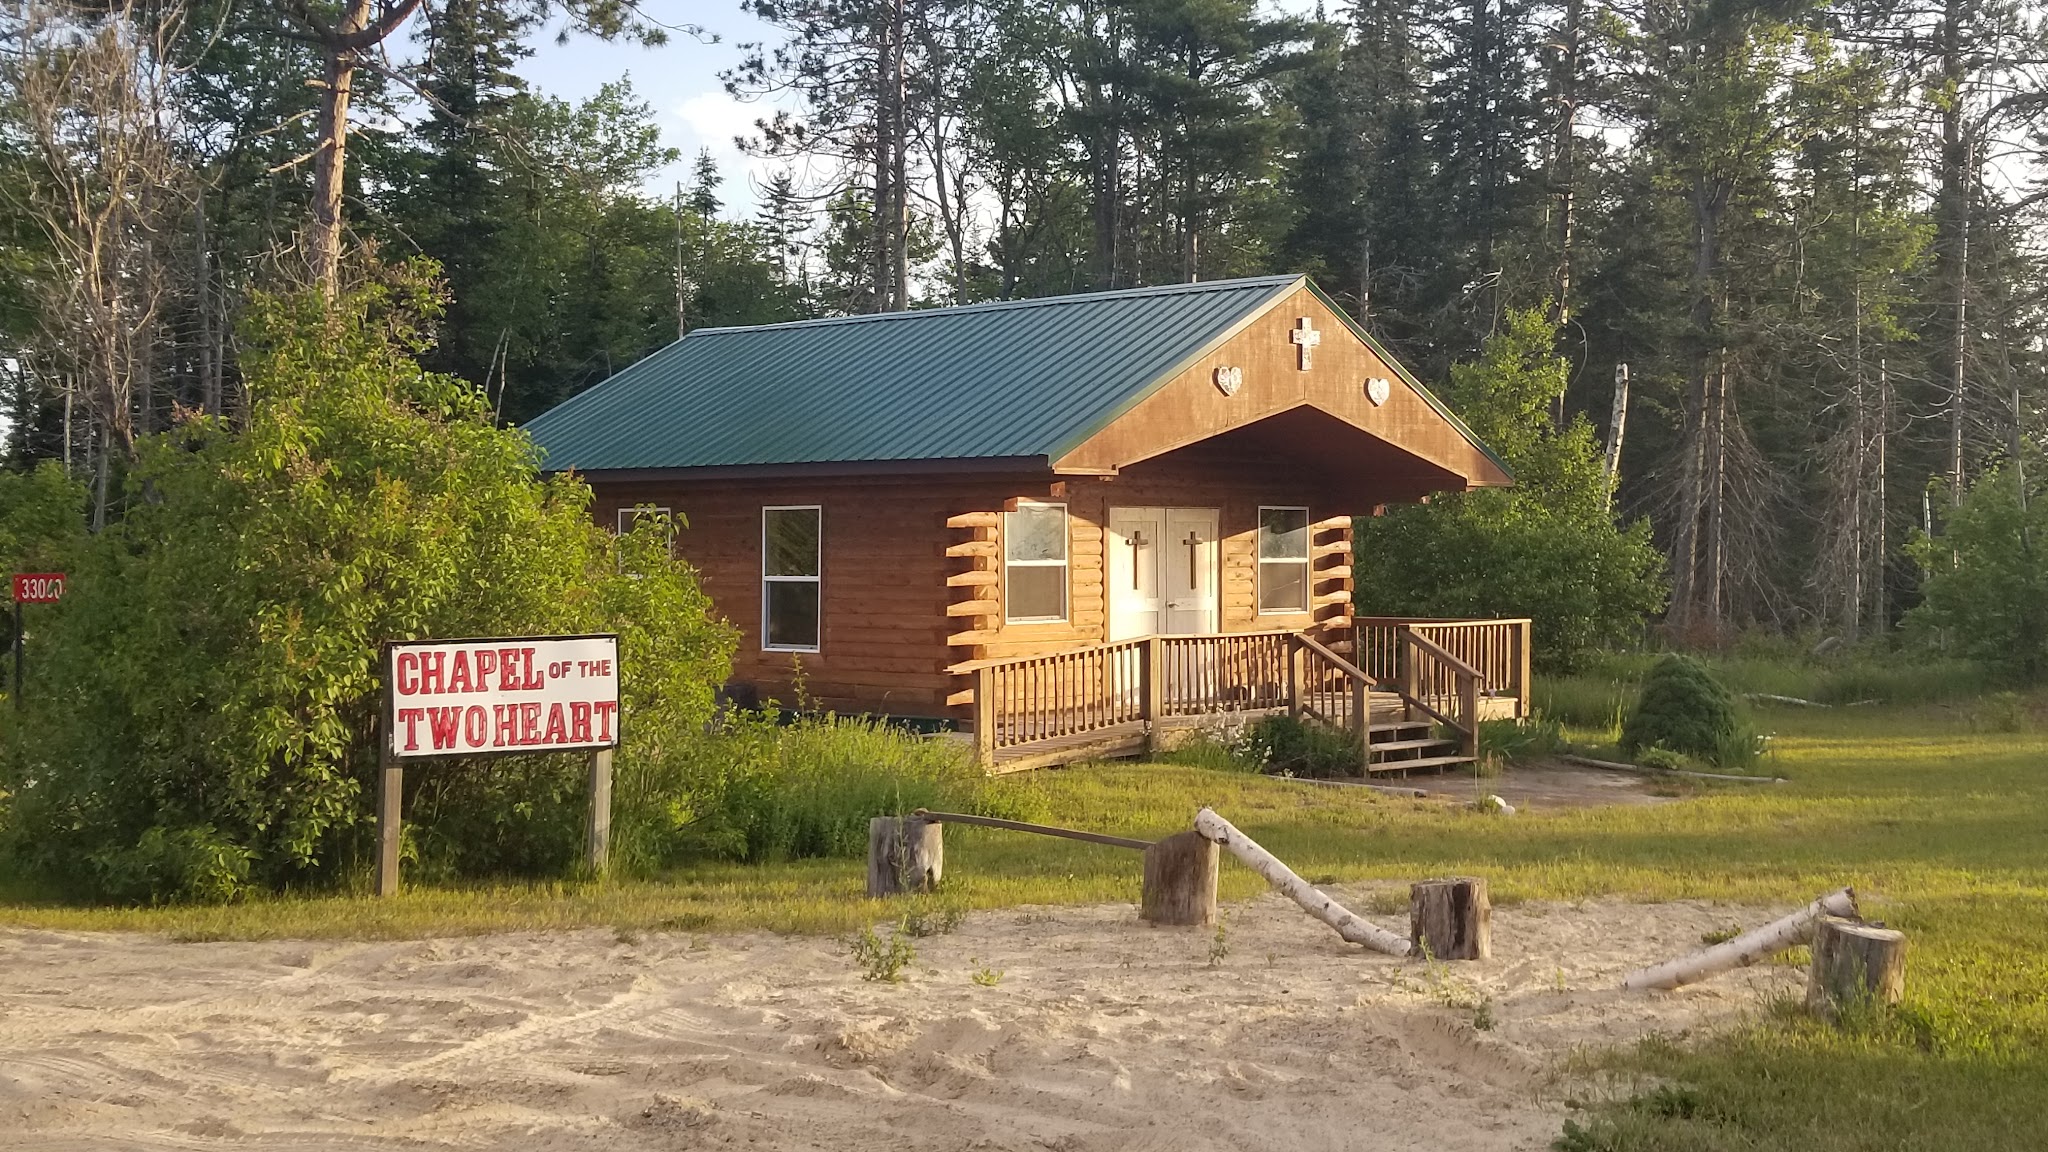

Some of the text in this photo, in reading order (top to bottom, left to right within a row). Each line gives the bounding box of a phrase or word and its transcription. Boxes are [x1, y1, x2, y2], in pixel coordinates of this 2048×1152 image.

[397, 647, 611, 695] CHAPEL OF THE
[398, 700, 617, 751] TWO HEART
